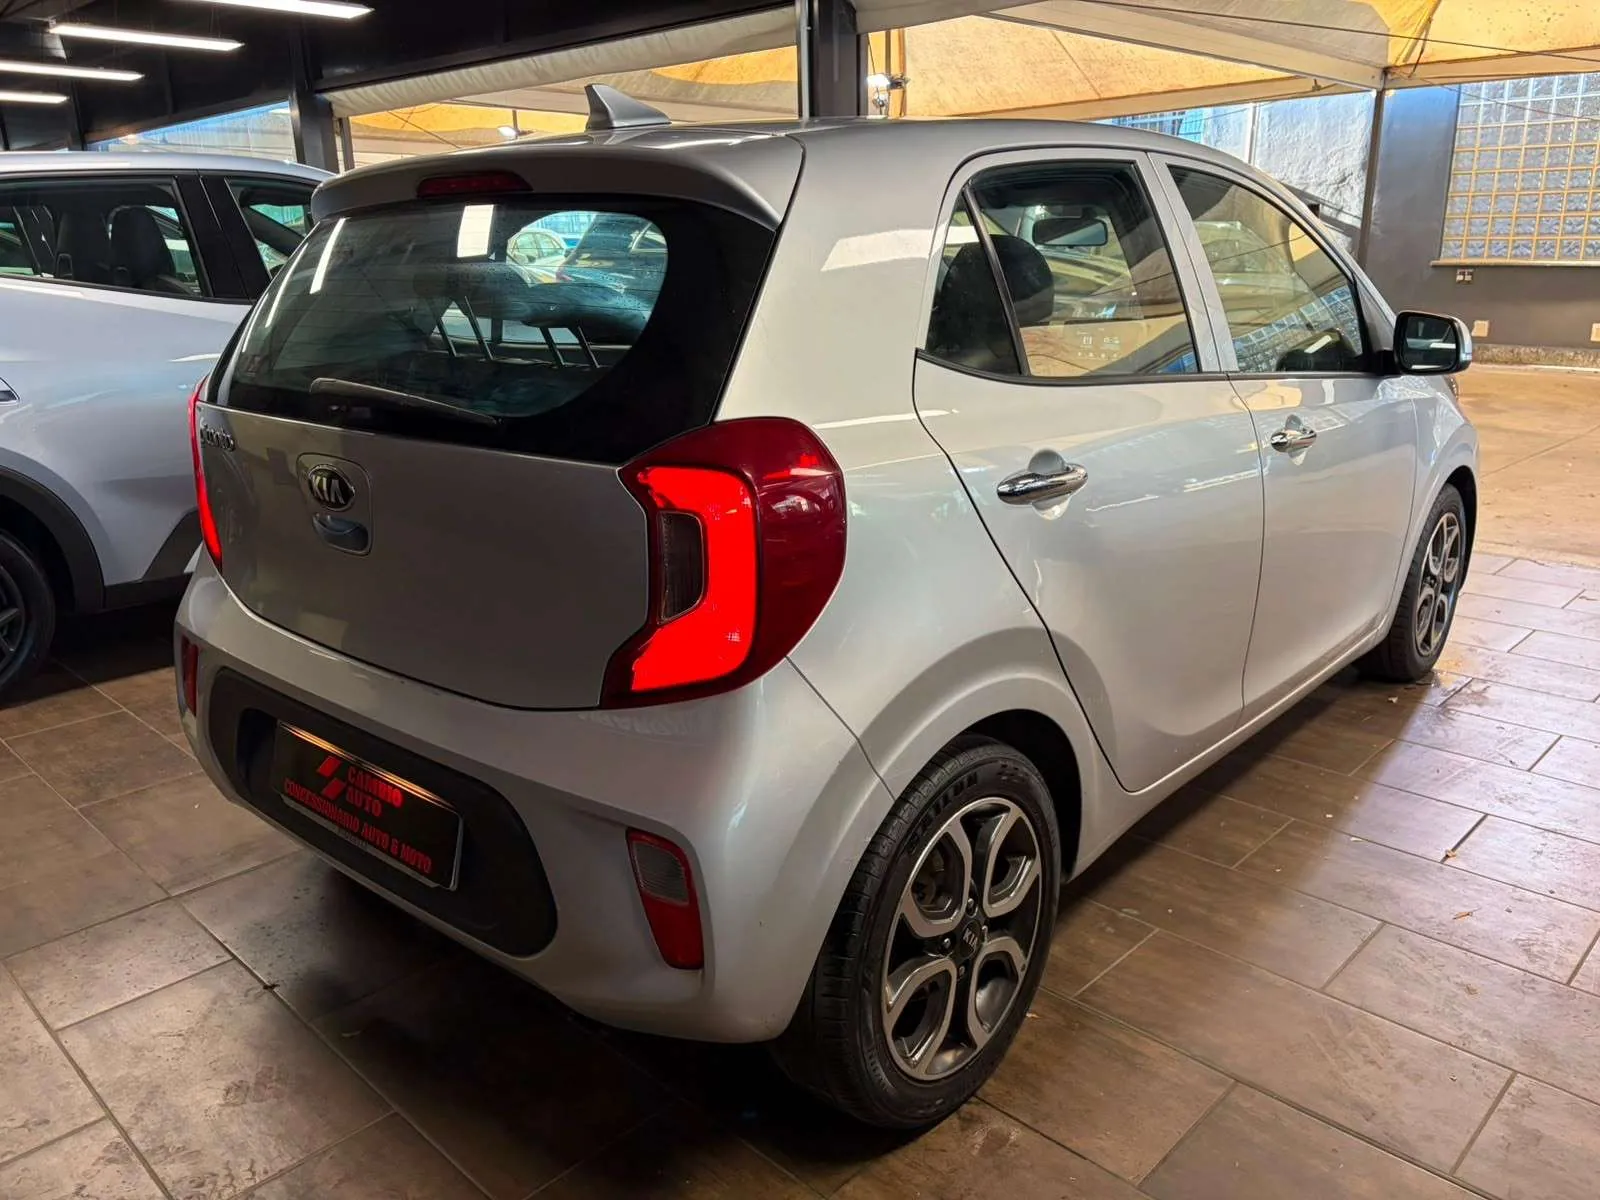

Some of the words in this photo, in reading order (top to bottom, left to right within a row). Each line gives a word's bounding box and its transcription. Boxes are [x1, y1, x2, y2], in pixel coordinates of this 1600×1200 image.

[312, 474, 346, 505] KIA
[345, 786, 382, 817] AUTO
[361, 820, 390, 850] AUTO
[390, 837, 399, 856] &
[400, 842, 433, 874] MOTO
